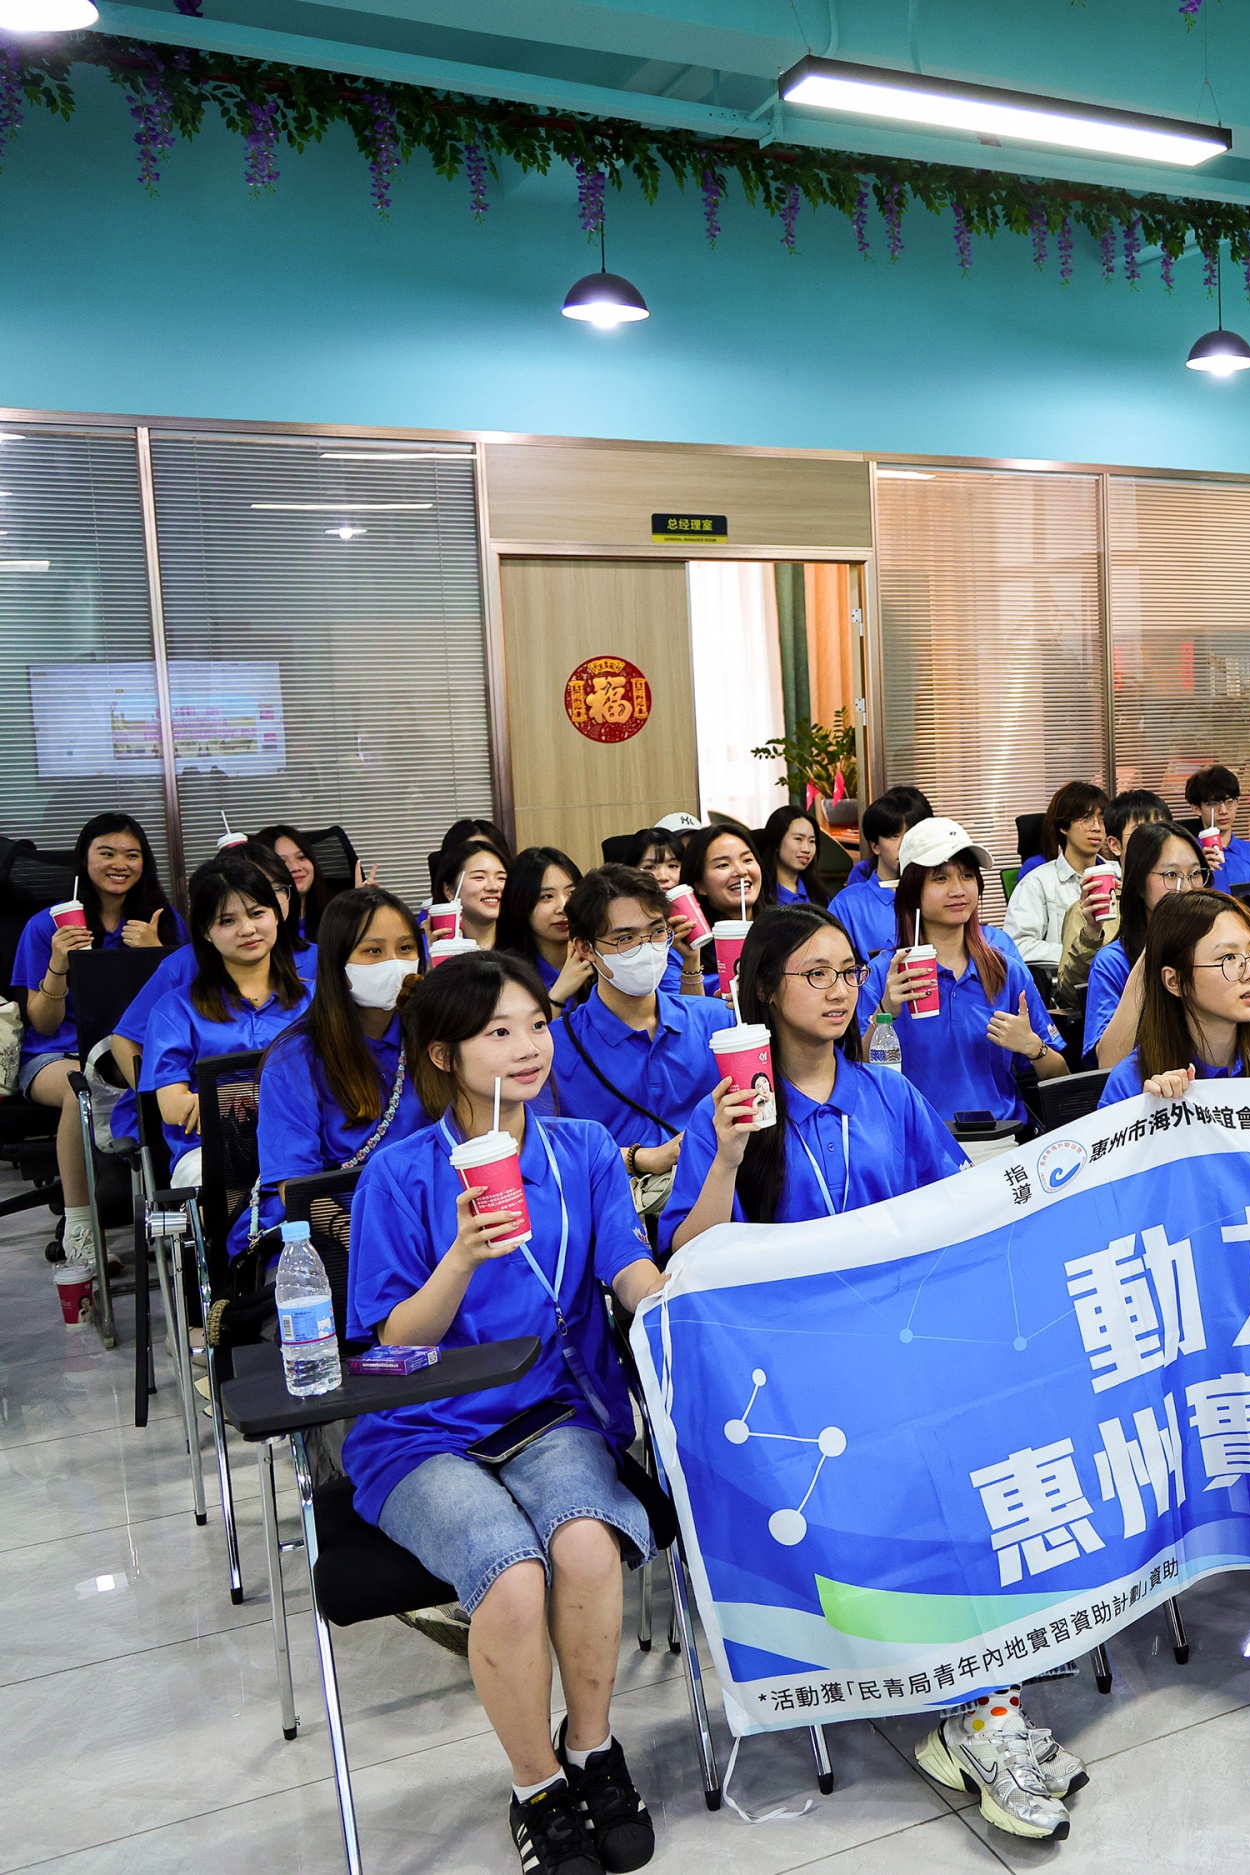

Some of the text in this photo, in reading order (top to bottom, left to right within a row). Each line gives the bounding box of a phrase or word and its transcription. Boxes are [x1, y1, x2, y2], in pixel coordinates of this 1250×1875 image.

[667, 518, 713, 531] 总经理室
[586, 676, 633, 724] 福
[1004, 1165, 1032, 1205] 指導
